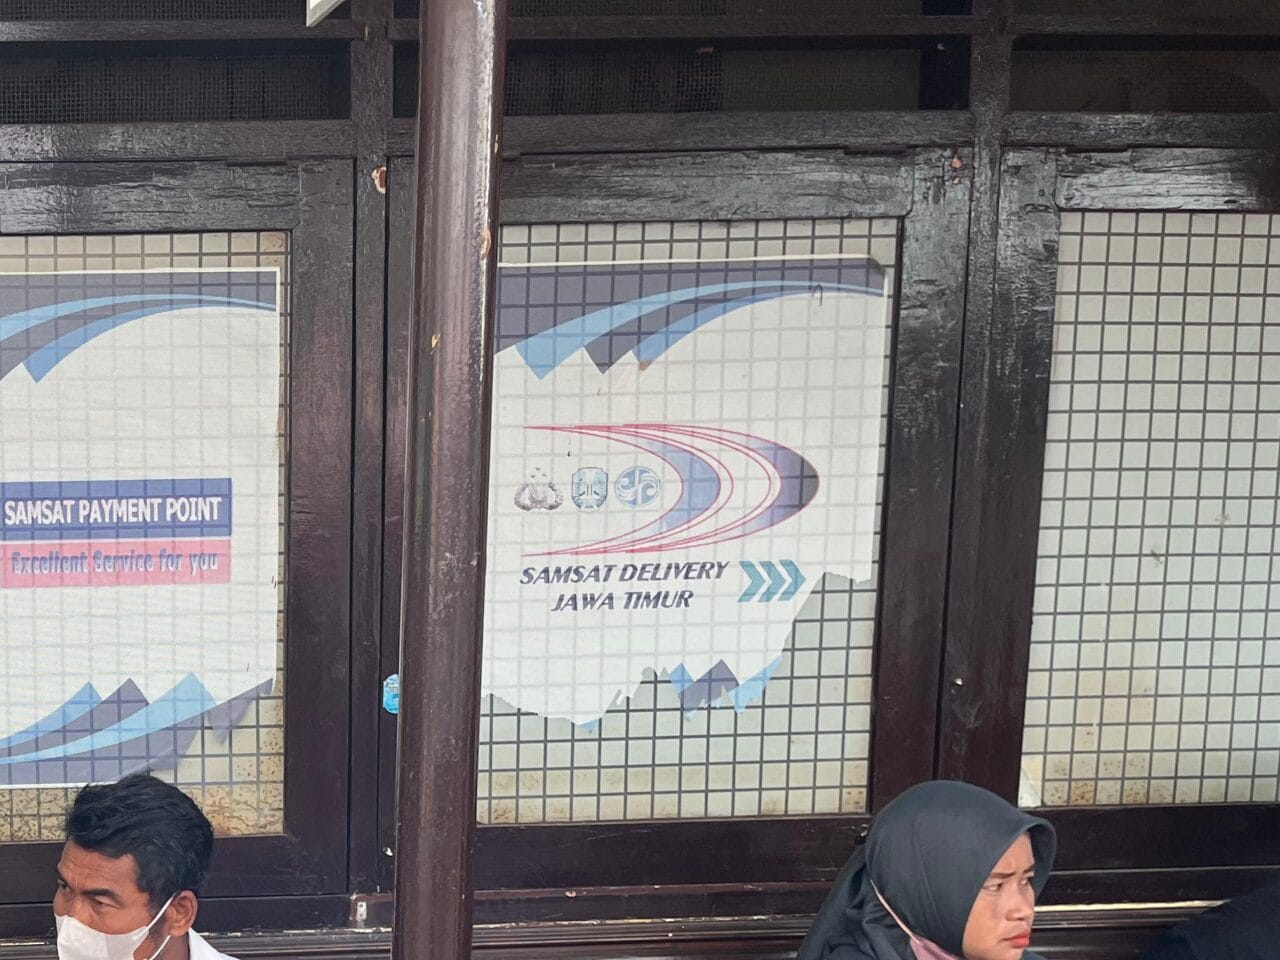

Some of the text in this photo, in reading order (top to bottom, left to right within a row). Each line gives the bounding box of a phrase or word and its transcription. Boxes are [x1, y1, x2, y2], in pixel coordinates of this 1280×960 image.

[4, 496, 222, 526] SAMSAT PAYMENT POINT
[11, 547, 219, 576] Excellent Service for you
[519, 561, 731, 585] SAMSAT DELIVERY
[551, 590, 695, 612] JAWA TIMUR
